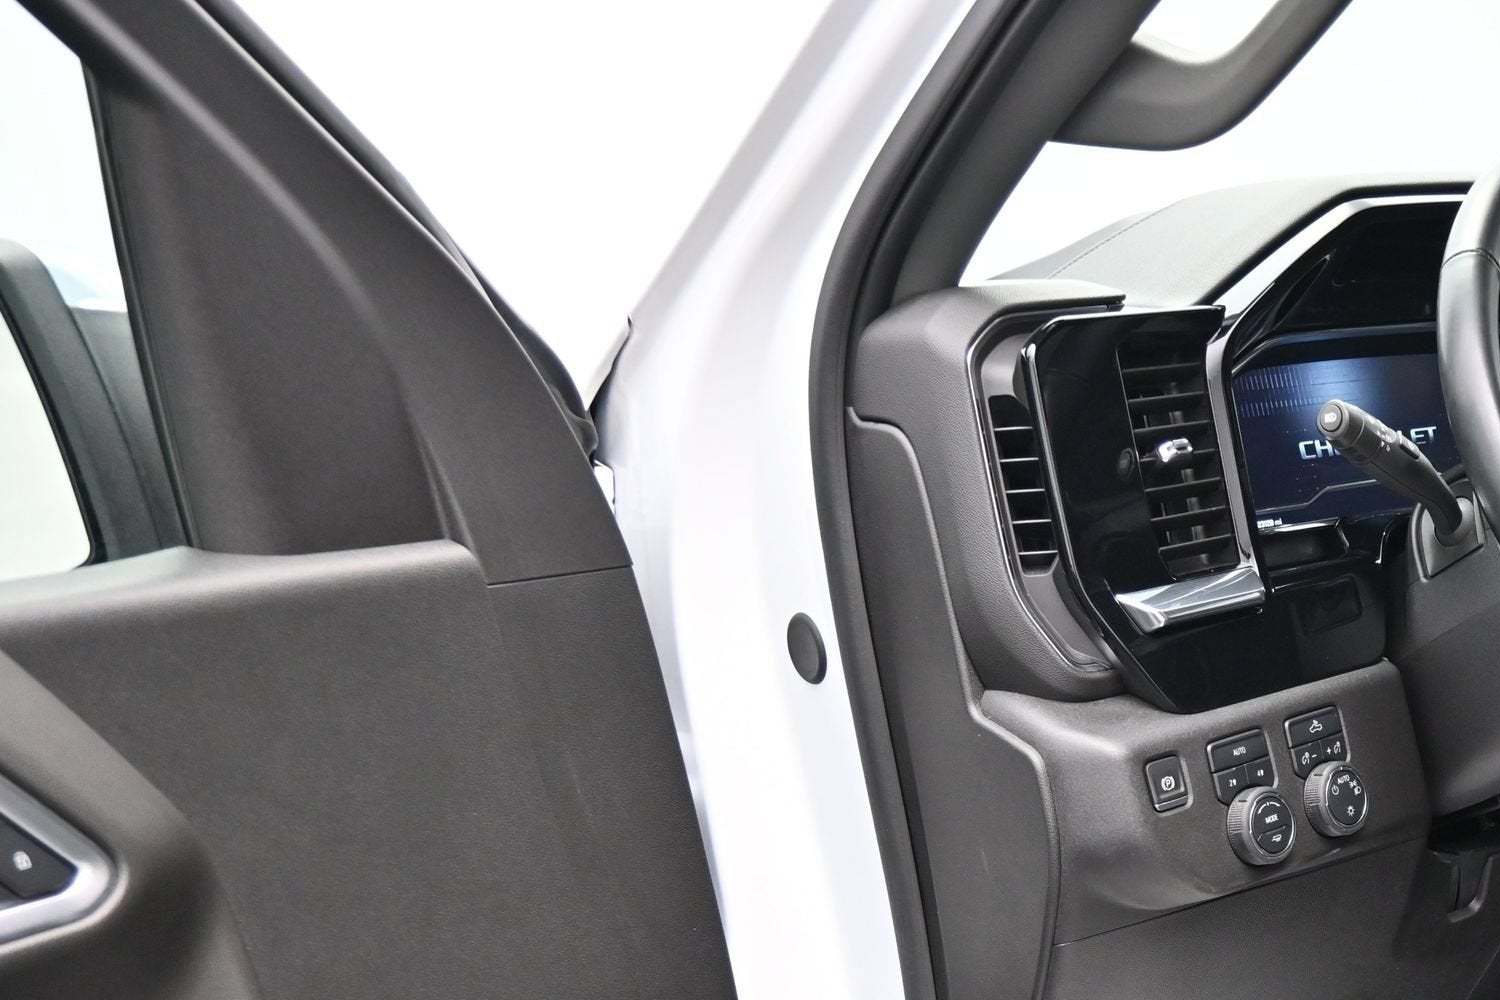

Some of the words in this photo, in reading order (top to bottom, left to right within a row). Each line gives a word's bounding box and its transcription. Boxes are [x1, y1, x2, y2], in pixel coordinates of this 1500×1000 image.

[1233, 746, 1247, 757] AUTO
[1337, 774, 1350, 785] AUTO
[1265, 813, 1279, 825] MODE
